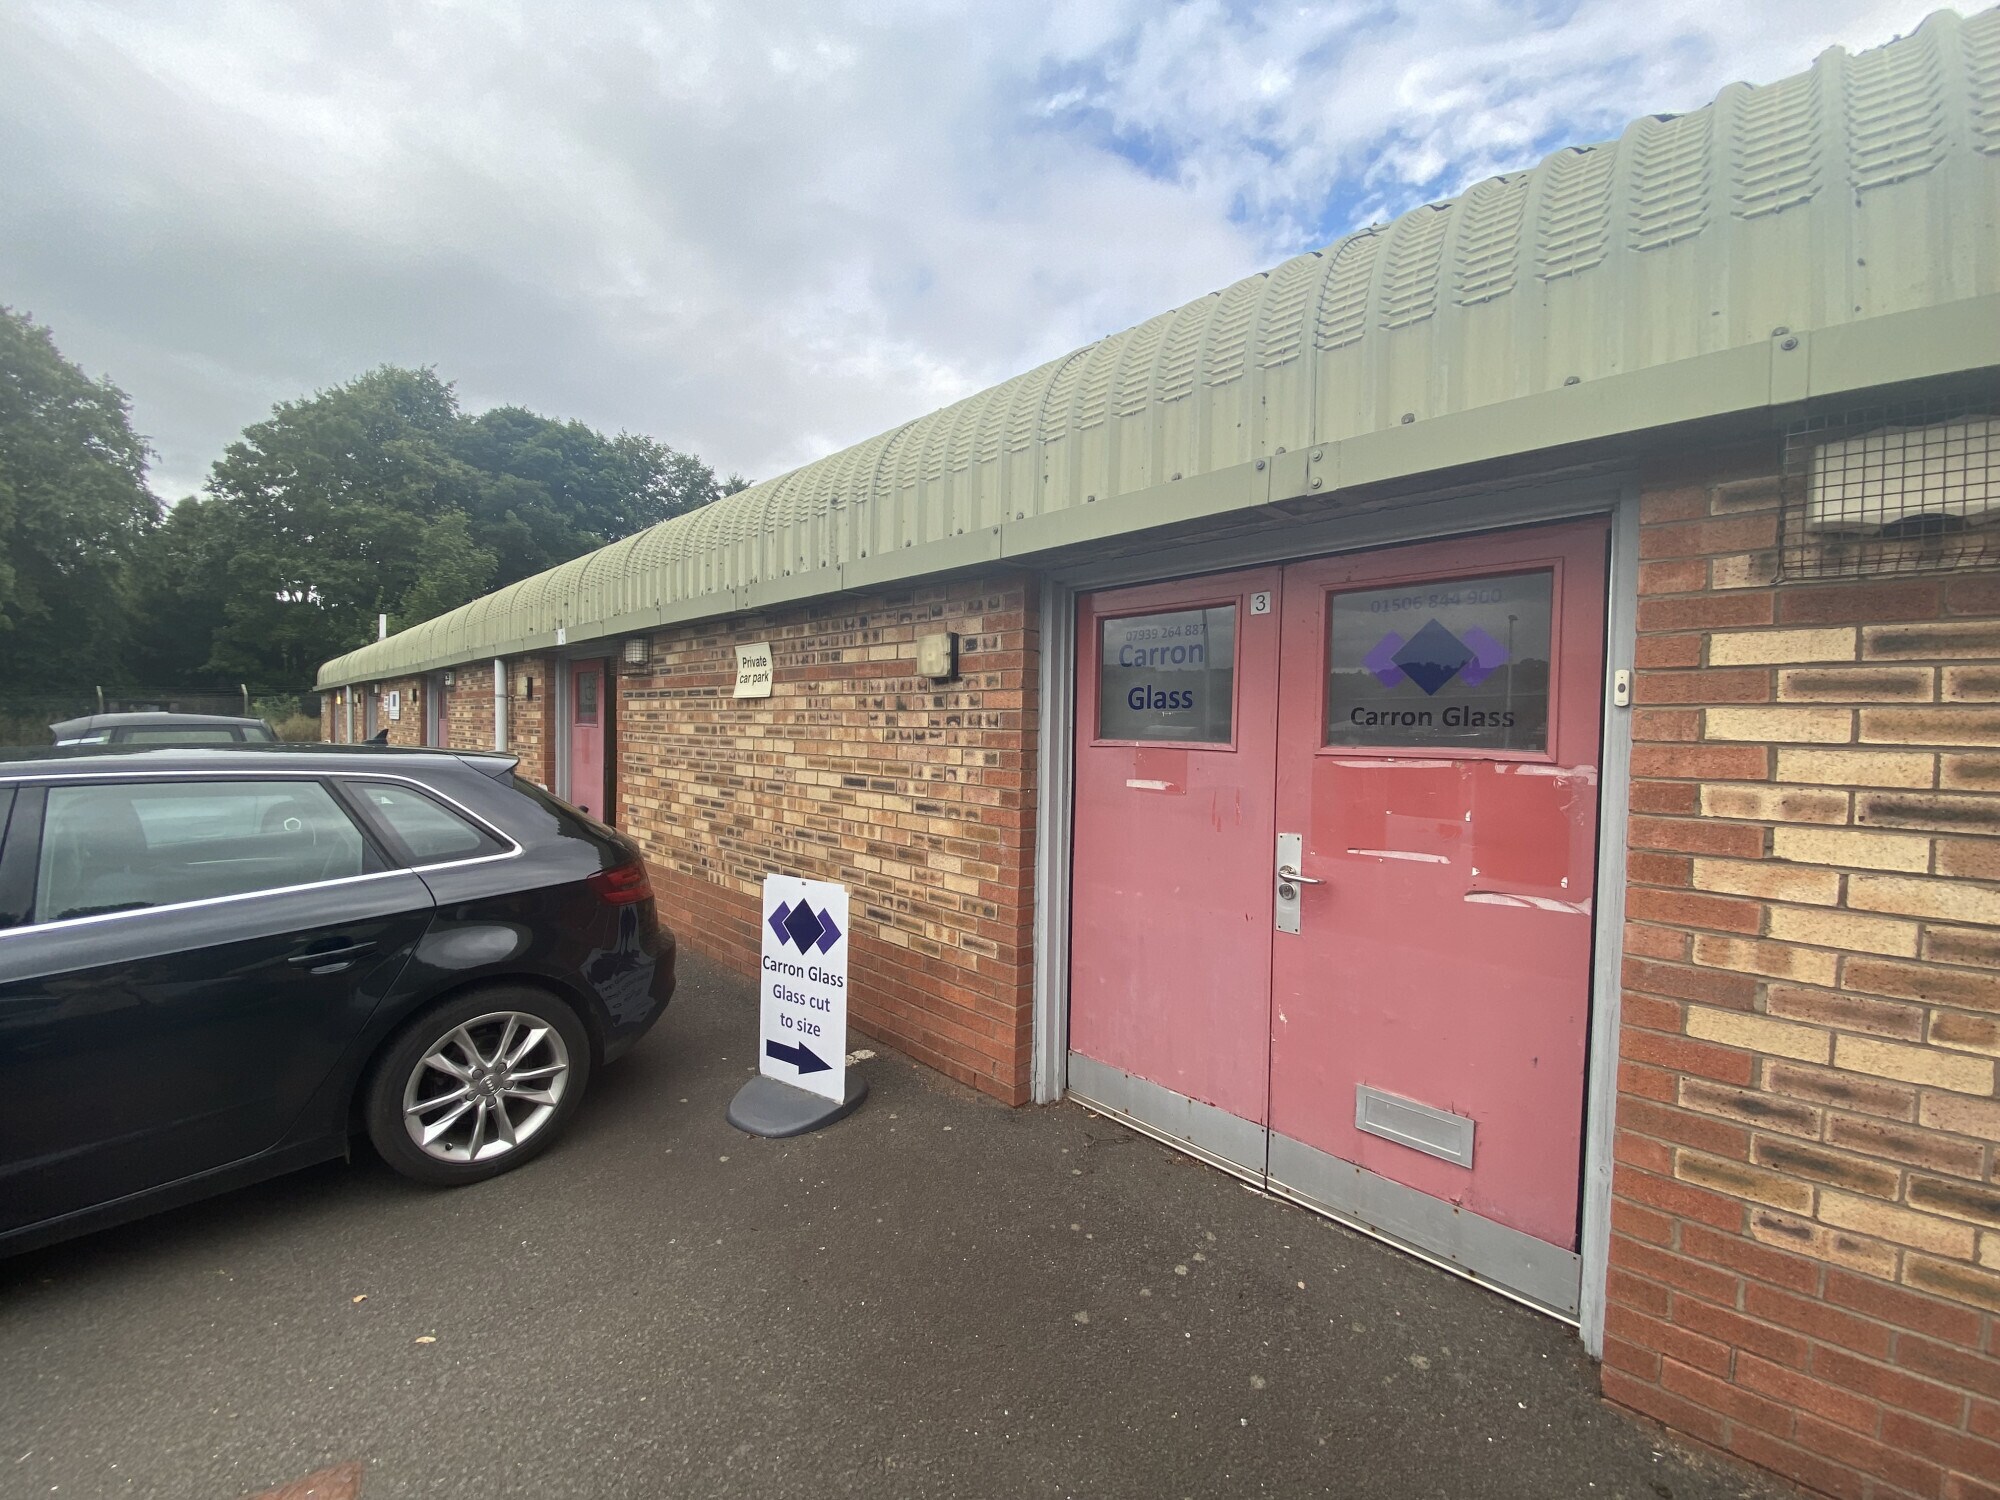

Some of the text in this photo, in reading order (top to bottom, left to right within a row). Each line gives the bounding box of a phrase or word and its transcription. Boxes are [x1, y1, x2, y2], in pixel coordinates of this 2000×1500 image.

[1255, 594, 1266, 612] 3
[1370, 595, 1423, 613] 01506
[1428, 592, 1461, 608] 844
[1126, 623, 1206, 642] 07939 264 887
[742, 656, 767, 669] Private
[1119, 643, 1204, 668] Carron
[740, 671, 769, 686] car park
[1127, 684, 1193, 710] Glass
[1350, 705, 1515, 728] Carron Glass
[762, 955, 844, 988] Carron Glass
[773, 984, 831, 1013] Glass cut
[780, 1012, 821, 1037] to size
